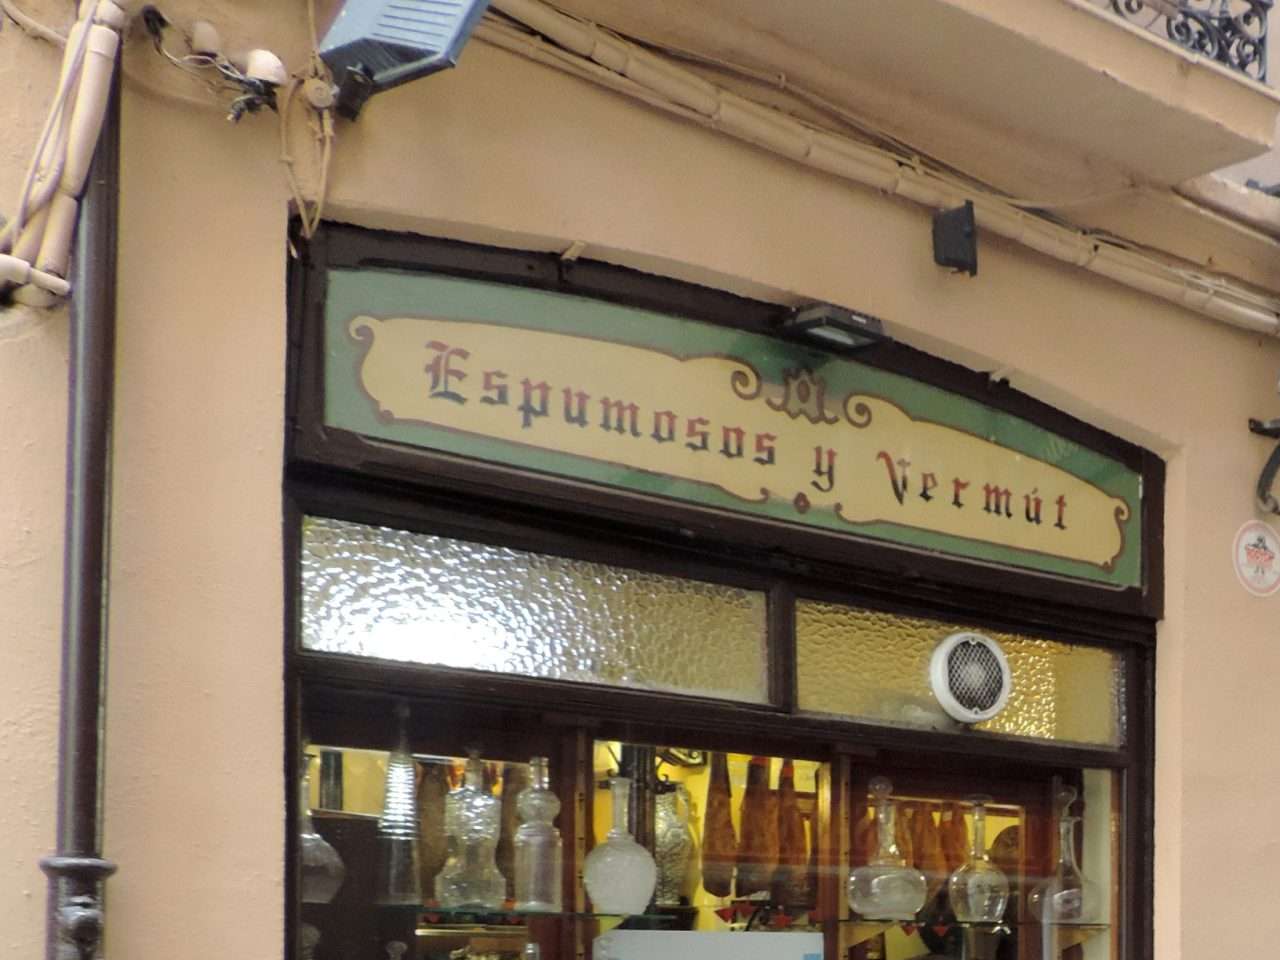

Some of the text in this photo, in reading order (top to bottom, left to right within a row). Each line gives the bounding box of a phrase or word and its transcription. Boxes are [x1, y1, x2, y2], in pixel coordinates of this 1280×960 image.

[425, 341, 1069, 531] Espumosos y Vermút
